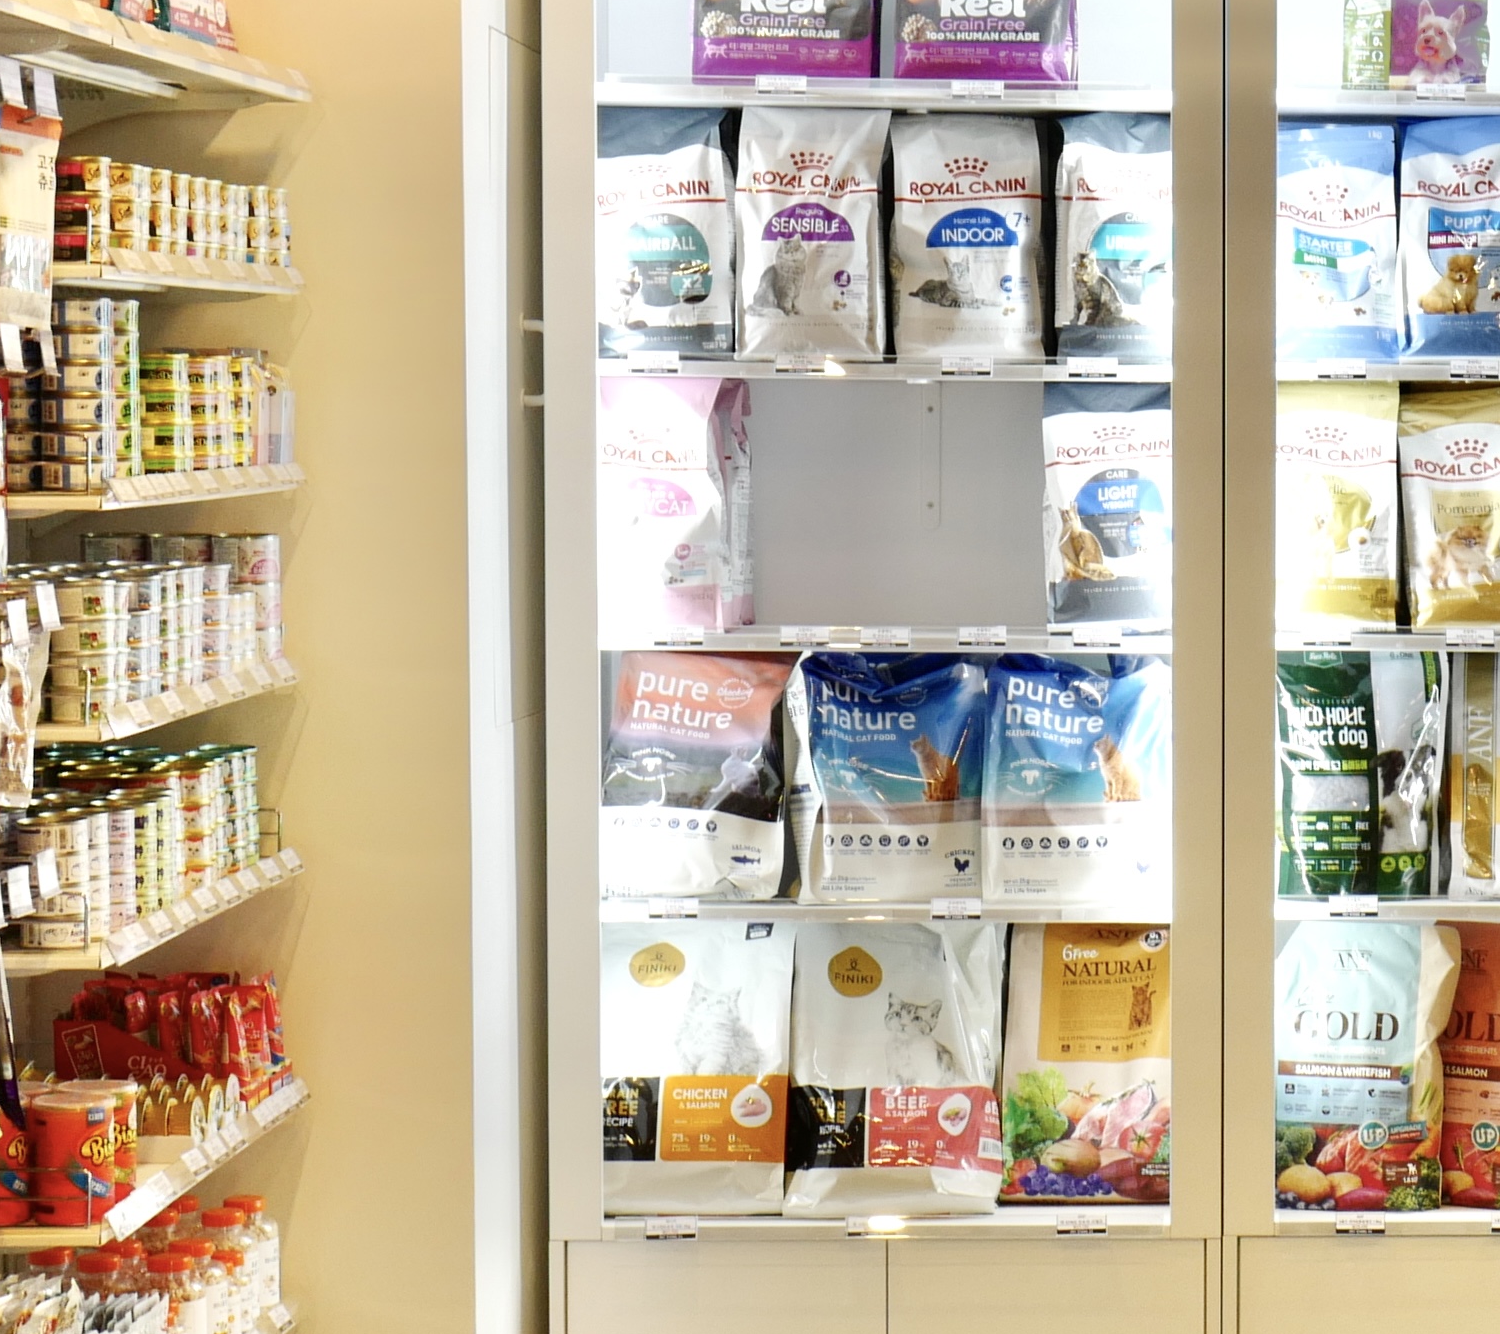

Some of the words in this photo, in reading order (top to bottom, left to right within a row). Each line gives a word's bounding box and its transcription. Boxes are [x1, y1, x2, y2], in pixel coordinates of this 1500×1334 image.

[740, 13, 786, 27] Grain
[790, 13, 826, 27] Free
[940, 17, 986, 31] Grain
[989, 18, 1025, 31] Free
[910, 178, 964, 195] ROYAL
[968, 177, 1026, 193] CANIN
[1418, 178, 1470, 197] ROYAL
[772, 217, 840, 233] SENSIBLE
[1444, 214, 1492, 230] PUPPY
[942, 227, 1004, 243] INDOOR
[1056, 443, 1108, 459] ROYAL
[1114, 439, 1170, 455] CANIN
[1106, 470, 1128, 479] CARE
[1415, 458, 1465, 477] ROYAL
[1098, 485, 1138, 501] LIGHT
[638, 671, 708, 703] pure
[1008, 677, 1076, 709] pure
[634, 698, 733, 729] nature
[822, 701, 916, 731] nature
[1006, 701, 1104, 733] nature
[1062, 958, 1156, 977] NATURAL
[1295, 1011, 1399, 1042] GOLD
[673, 1089, 728, 1101] CHICKEN
[885, 1095, 927, 1111] BEEF
[1361, 1124, 1387, 1144] UP
